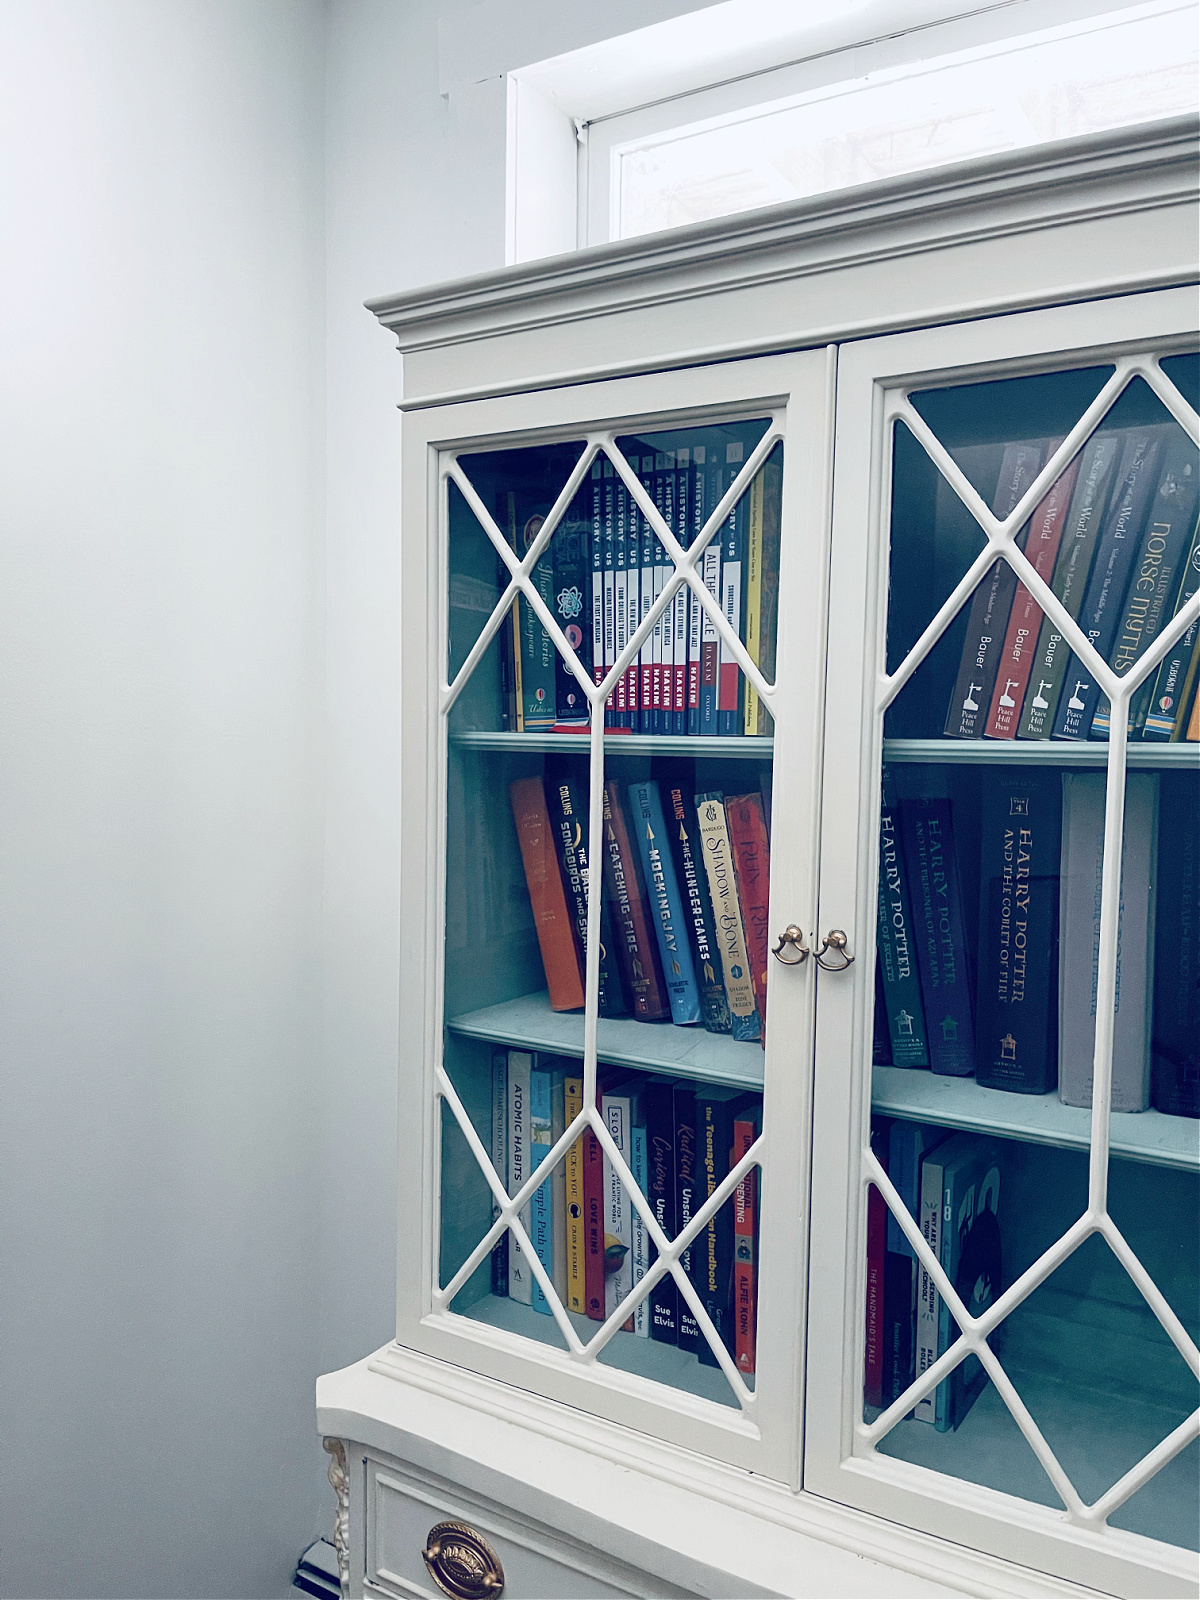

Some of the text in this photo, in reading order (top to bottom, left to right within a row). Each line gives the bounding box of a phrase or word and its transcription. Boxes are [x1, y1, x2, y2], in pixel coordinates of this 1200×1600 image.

[1009, 467, 1025, 493] Story
[1086, 459, 1103, 487] Story
[1125, 459, 1144, 486] Story
[1041, 507, 1057, 540] World
[1075, 507, 1092, 538] World
[1114, 507, 1132, 539] World
[593, 553, 600, 567] US
[606, 552, 612, 566] US
[618, 552, 624, 566] US
[630, 550, 636, 564] US
[643, 548, 650, 562] US
[656, 546, 661, 560] US
[729, 542, 735, 557] US
[706, 554, 717, 572] ALL
[976, 636, 992, 668] Bauer
[1012, 628, 1029, 661] Bauer
[1044, 634, 1061, 668] Bauer
[962, 710, 978, 719] Peace
[962, 718, 974, 727] Hill
[997, 707, 1014, 716] Peace
[997, 715, 1010, 723] Hill
[1030, 708, 1047, 718] Peace
[1030, 716, 1043, 725] Hill
[1066, 709, 1083, 718] Peace
[1066, 717, 1079, 726] Hill
[959, 725, 974, 734] Press
[995, 722, 1009, 731] Press
[1027, 723, 1043, 733] Press
[1063, 725, 1078, 734] Press
[559, 785, 573, 816] COLLINS
[637, 788, 651, 819] COLLINS
[671, 789, 685, 820] COLLINS
[578, 847, 587, 865] THE
[1004, 829, 1014, 862] AND
[561, 822, 585, 915] SONGBIRDS AND
[1002, 864, 1013, 895] THE
[609, 842, 638, 954] CATCHING FIRE
[649, 849, 677, 952] MOCKINGJAY
[706, 837, 731, 900] SHADOW
[720, 911, 740, 959] BONE
[881, 815, 911, 981] HARRY POTTER
[928, 819, 956, 985] HARRY POTTER
[1001, 897, 1012, 947] GOBLET
[1011, 827, 1033, 1004] HARRY POTTER
[694, 918, 710, 960] GAMES
[1000, 949, 1009, 968] OF
[513, 1083, 523, 1181] ATOMIC HABITS
[636, 1155, 642, 1163] to
[704, 1124, 715, 1173] Teenage
[537, 1219, 547, 1245] Path
[590, 1198, 598, 1255] LOVE WINS
[708, 1233, 717, 1292] Handbook
[655, 1304, 671, 1316] Sue
[740, 1275, 748, 1336] ALFIE KOHN
[868, 1285, 877, 1343] HANDMAID'S
[654, 1315, 675, 1328] Elvis
[682, 1315, 697, 1326] Sue
[868, 1344, 876, 1365] TALE
